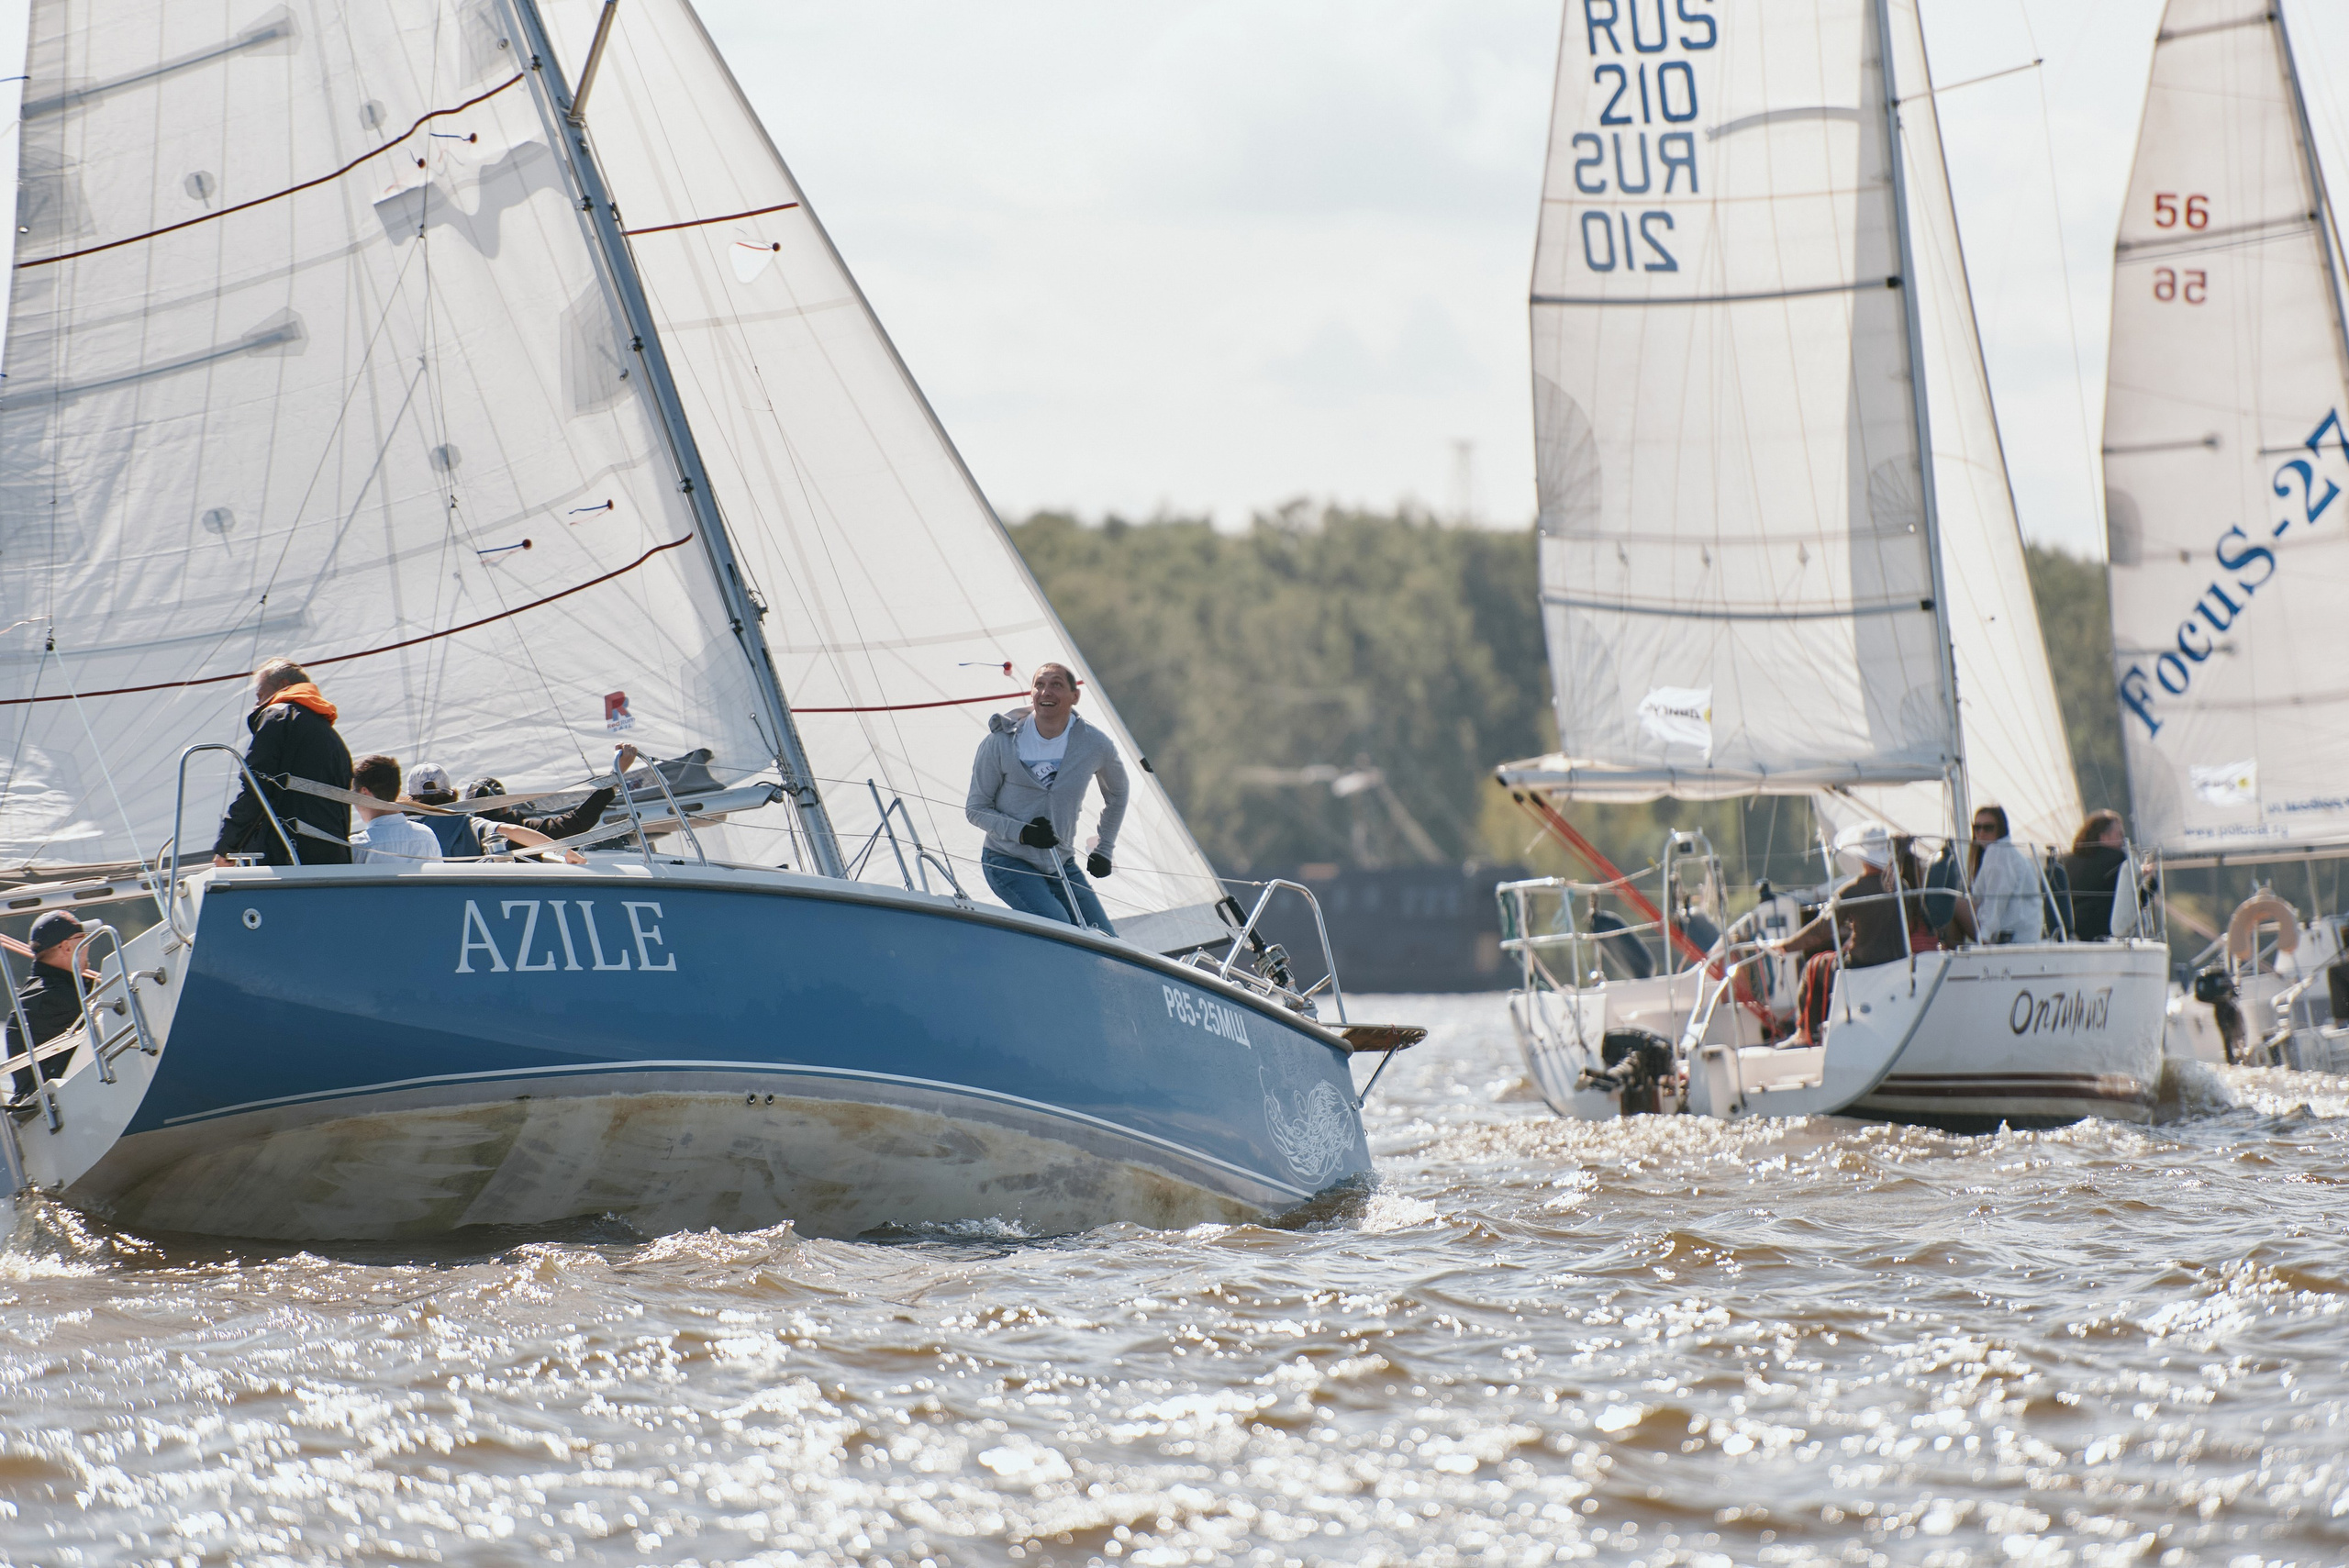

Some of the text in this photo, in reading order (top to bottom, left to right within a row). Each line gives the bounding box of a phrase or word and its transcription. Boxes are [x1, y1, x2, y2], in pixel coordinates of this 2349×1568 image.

[1584, 0, 1718, 55] RUS
[1594, 61, 1698, 126] 210
[2154, 194, 2210, 229] 56
[455, 900, 677, 973] AZILE
